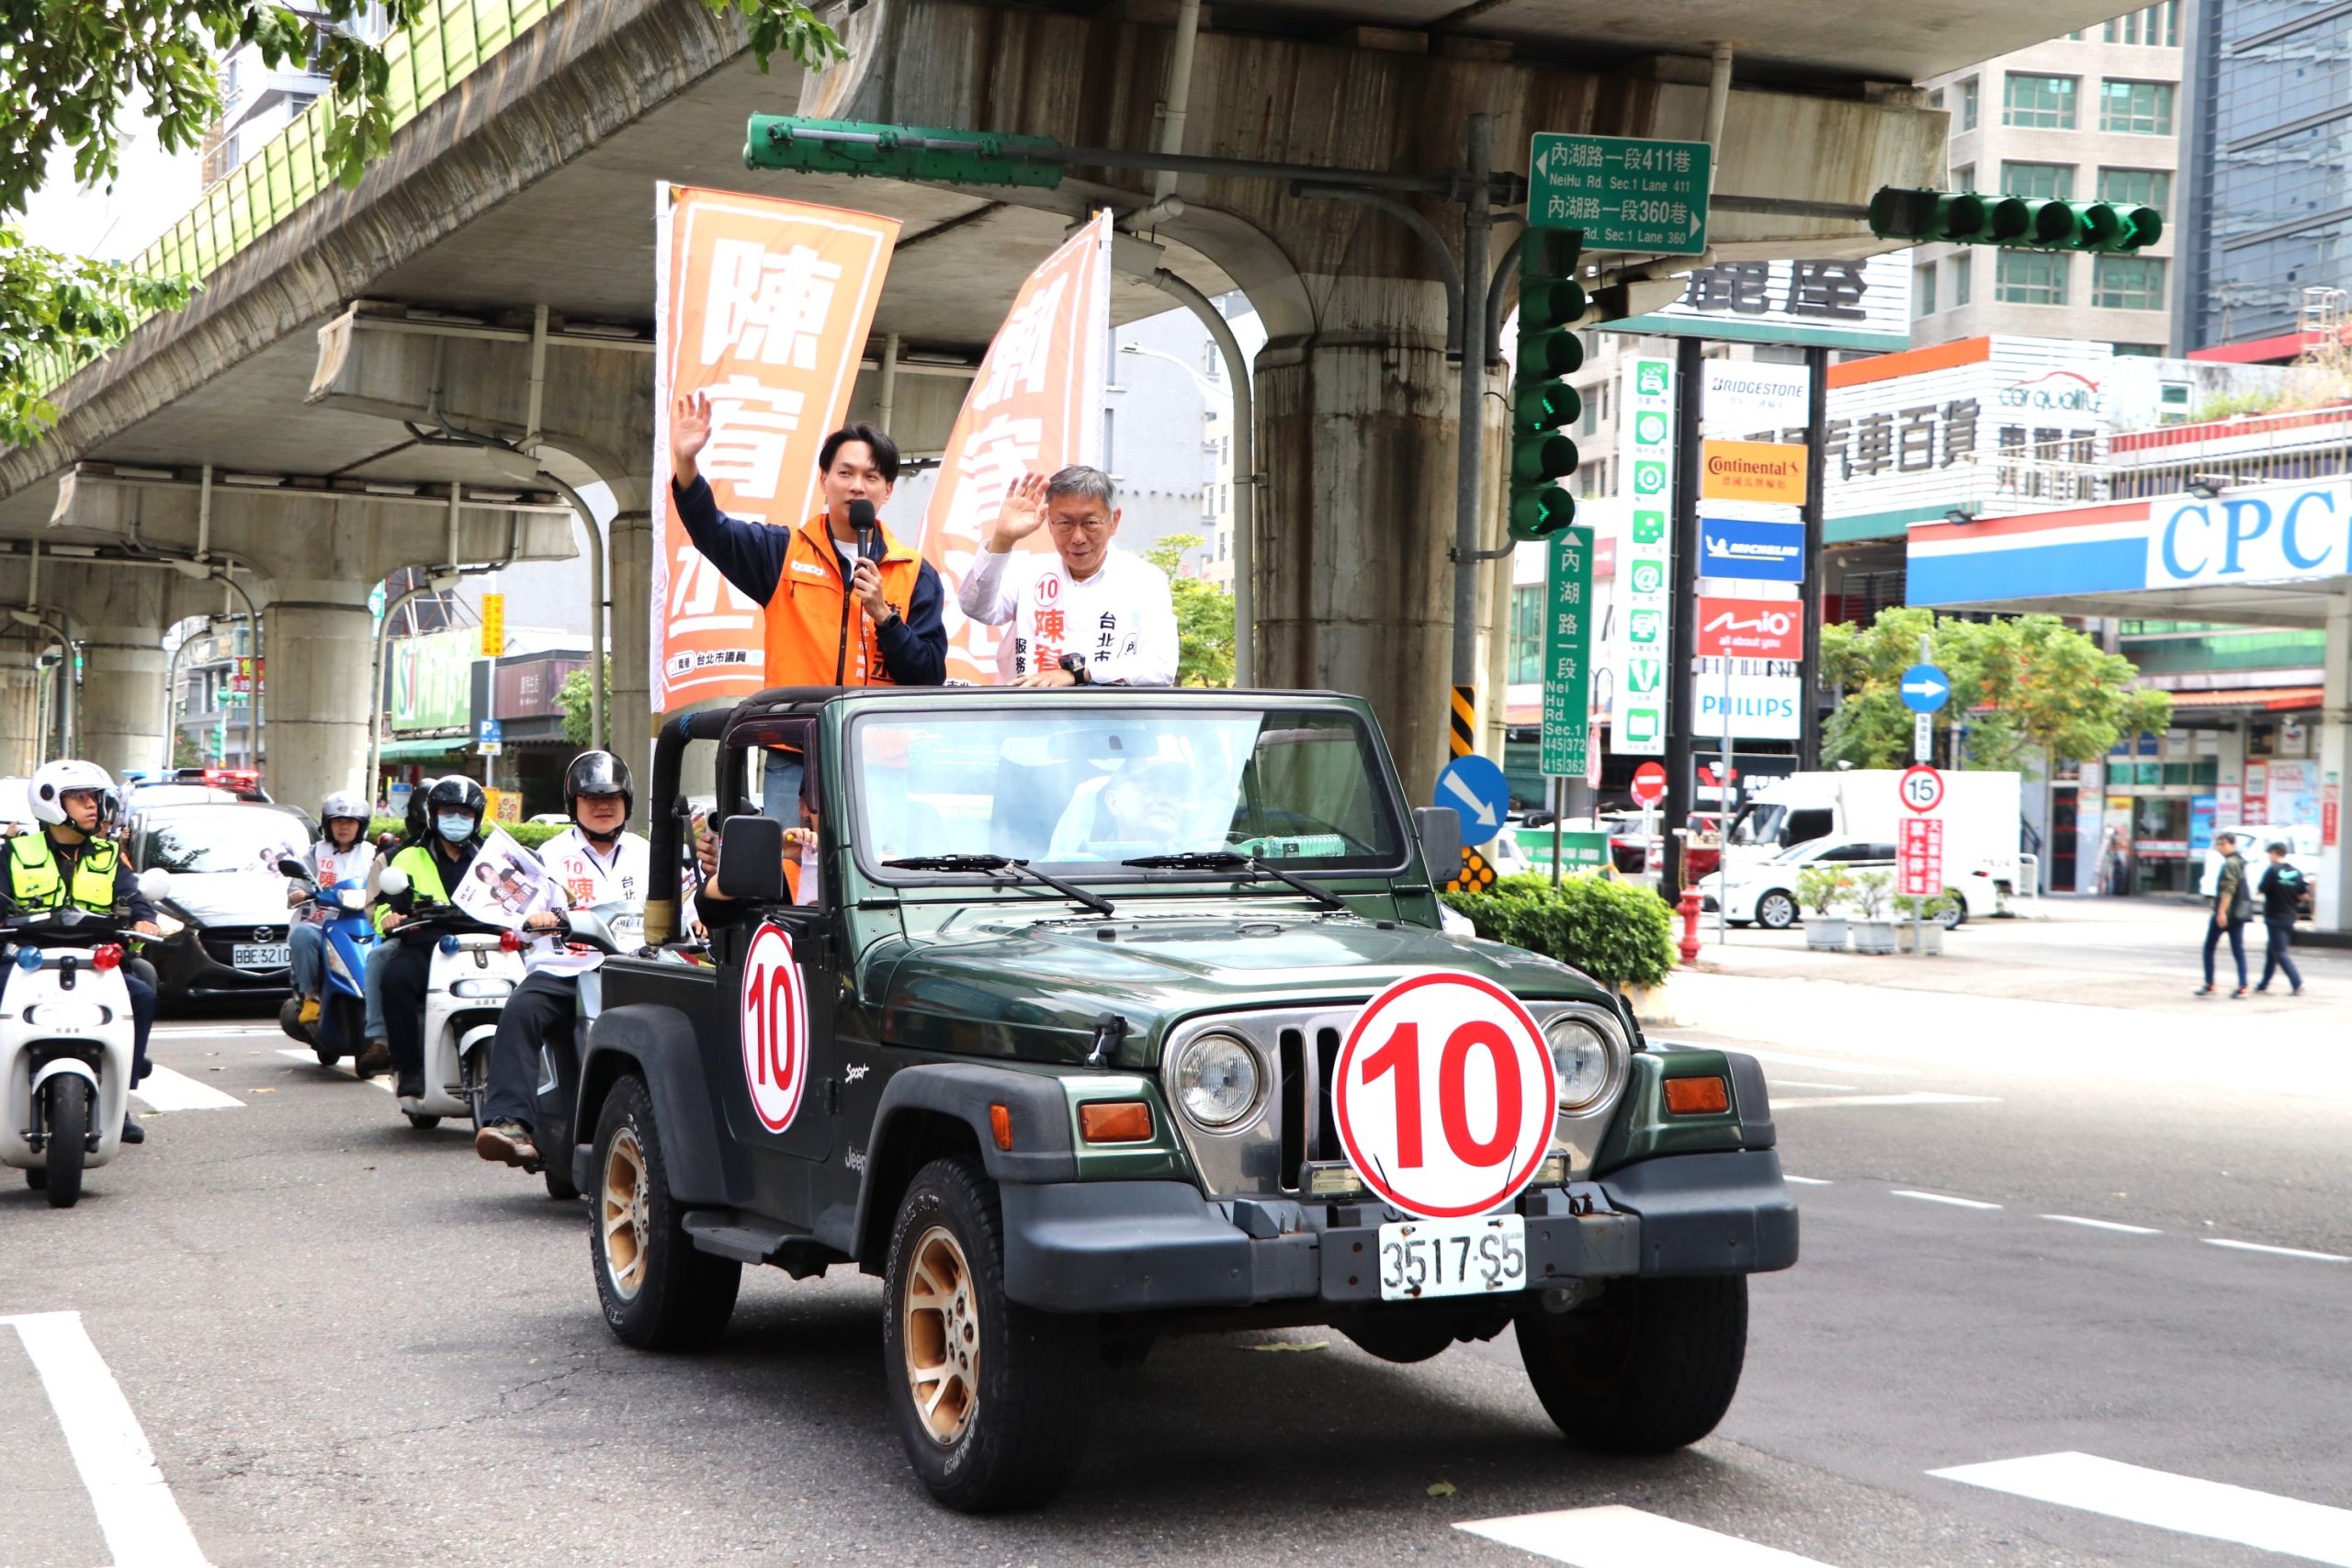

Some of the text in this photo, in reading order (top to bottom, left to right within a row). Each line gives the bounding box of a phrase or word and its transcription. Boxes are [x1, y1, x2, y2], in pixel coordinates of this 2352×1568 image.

[1551, 142, 1690, 173] 內湖路一段411巷
[1550, 173, 1690, 193] NeiHu Rd. Sec.1 Lane 411
[1548, 195, 1688, 225] 內湖路一段360巷
[1605, 229, 1633, 243] Sec.1
[1638, 230, 1663, 244] Lane
[1668, 231, 1686, 244] 360
[1712, 378, 1804, 398] BRIDGESTONE
[1708, 456, 1786, 476] Continental
[2162, 490, 2335, 580] CPC
[1729, 543, 1799, 557] MICHELIN
[1037, 579, 1058, 600] 10
[1556, 548, 1580, 680] 內湖路一段
[1545, 680, 1569, 694] Nei
[1544, 694, 1565, 707] Hu
[1702, 695, 1793, 717] PHILIPS
[1544, 708, 1566, 722] Rd.
[1544, 723, 1581, 737] Sec.1
[1544, 738, 1563, 751] 445
[1566, 738, 1586, 752] 372
[1544, 758, 1562, 772] 415
[1566, 759, 1585, 773] 362
[1908, 778, 1935, 801] 15
[320, 858, 334, 870] 10
[563, 859, 583, 874] 10
[748, 963, 796, 1091] 10
[1361, 1020, 1523, 1169] 10
